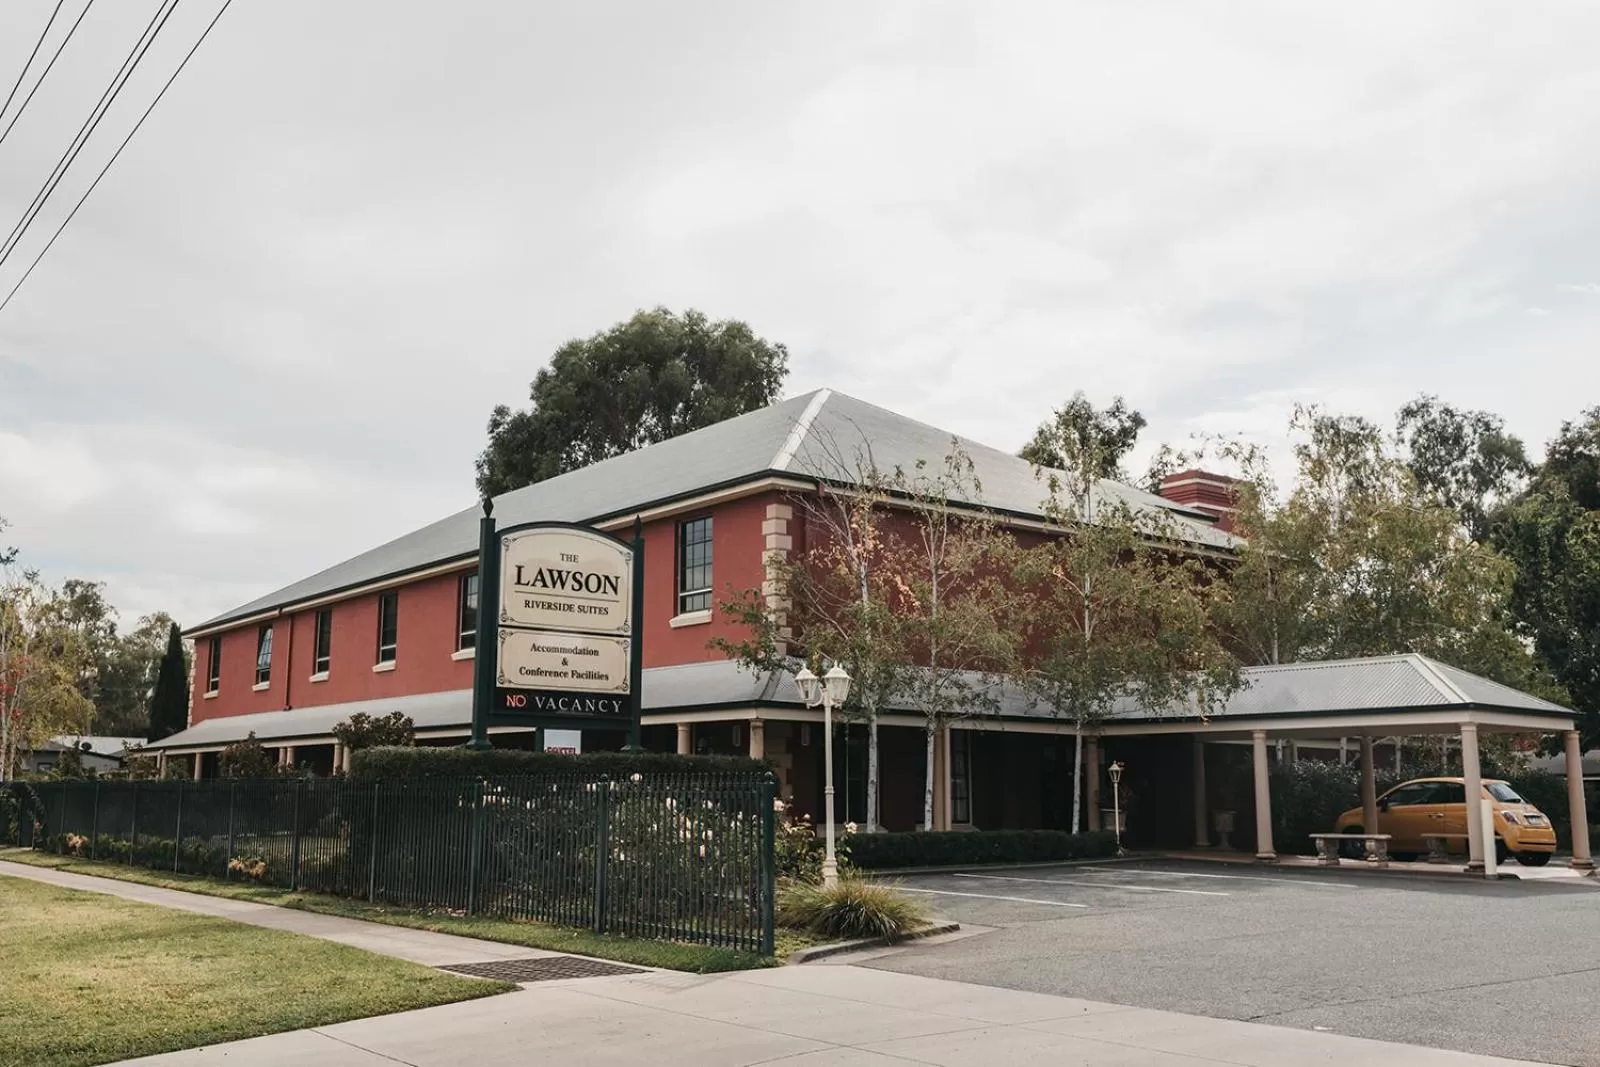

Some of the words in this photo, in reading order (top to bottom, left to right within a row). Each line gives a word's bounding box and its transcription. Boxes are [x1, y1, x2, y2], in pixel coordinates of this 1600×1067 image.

[560, 553, 579, 563] THE
[514, 565, 620, 596] LAWSON
[524, 600, 575, 613] RIVERSIDE
[577, 604, 609, 615] SUITES
[530, 643, 599, 656] Accommodation
[561, 657, 568, 666] &
[519, 666, 568, 678] Conference
[571, 670, 609, 681] Facilities
[506, 695, 527, 707] NO
[535, 696, 622, 712] VACANCY
